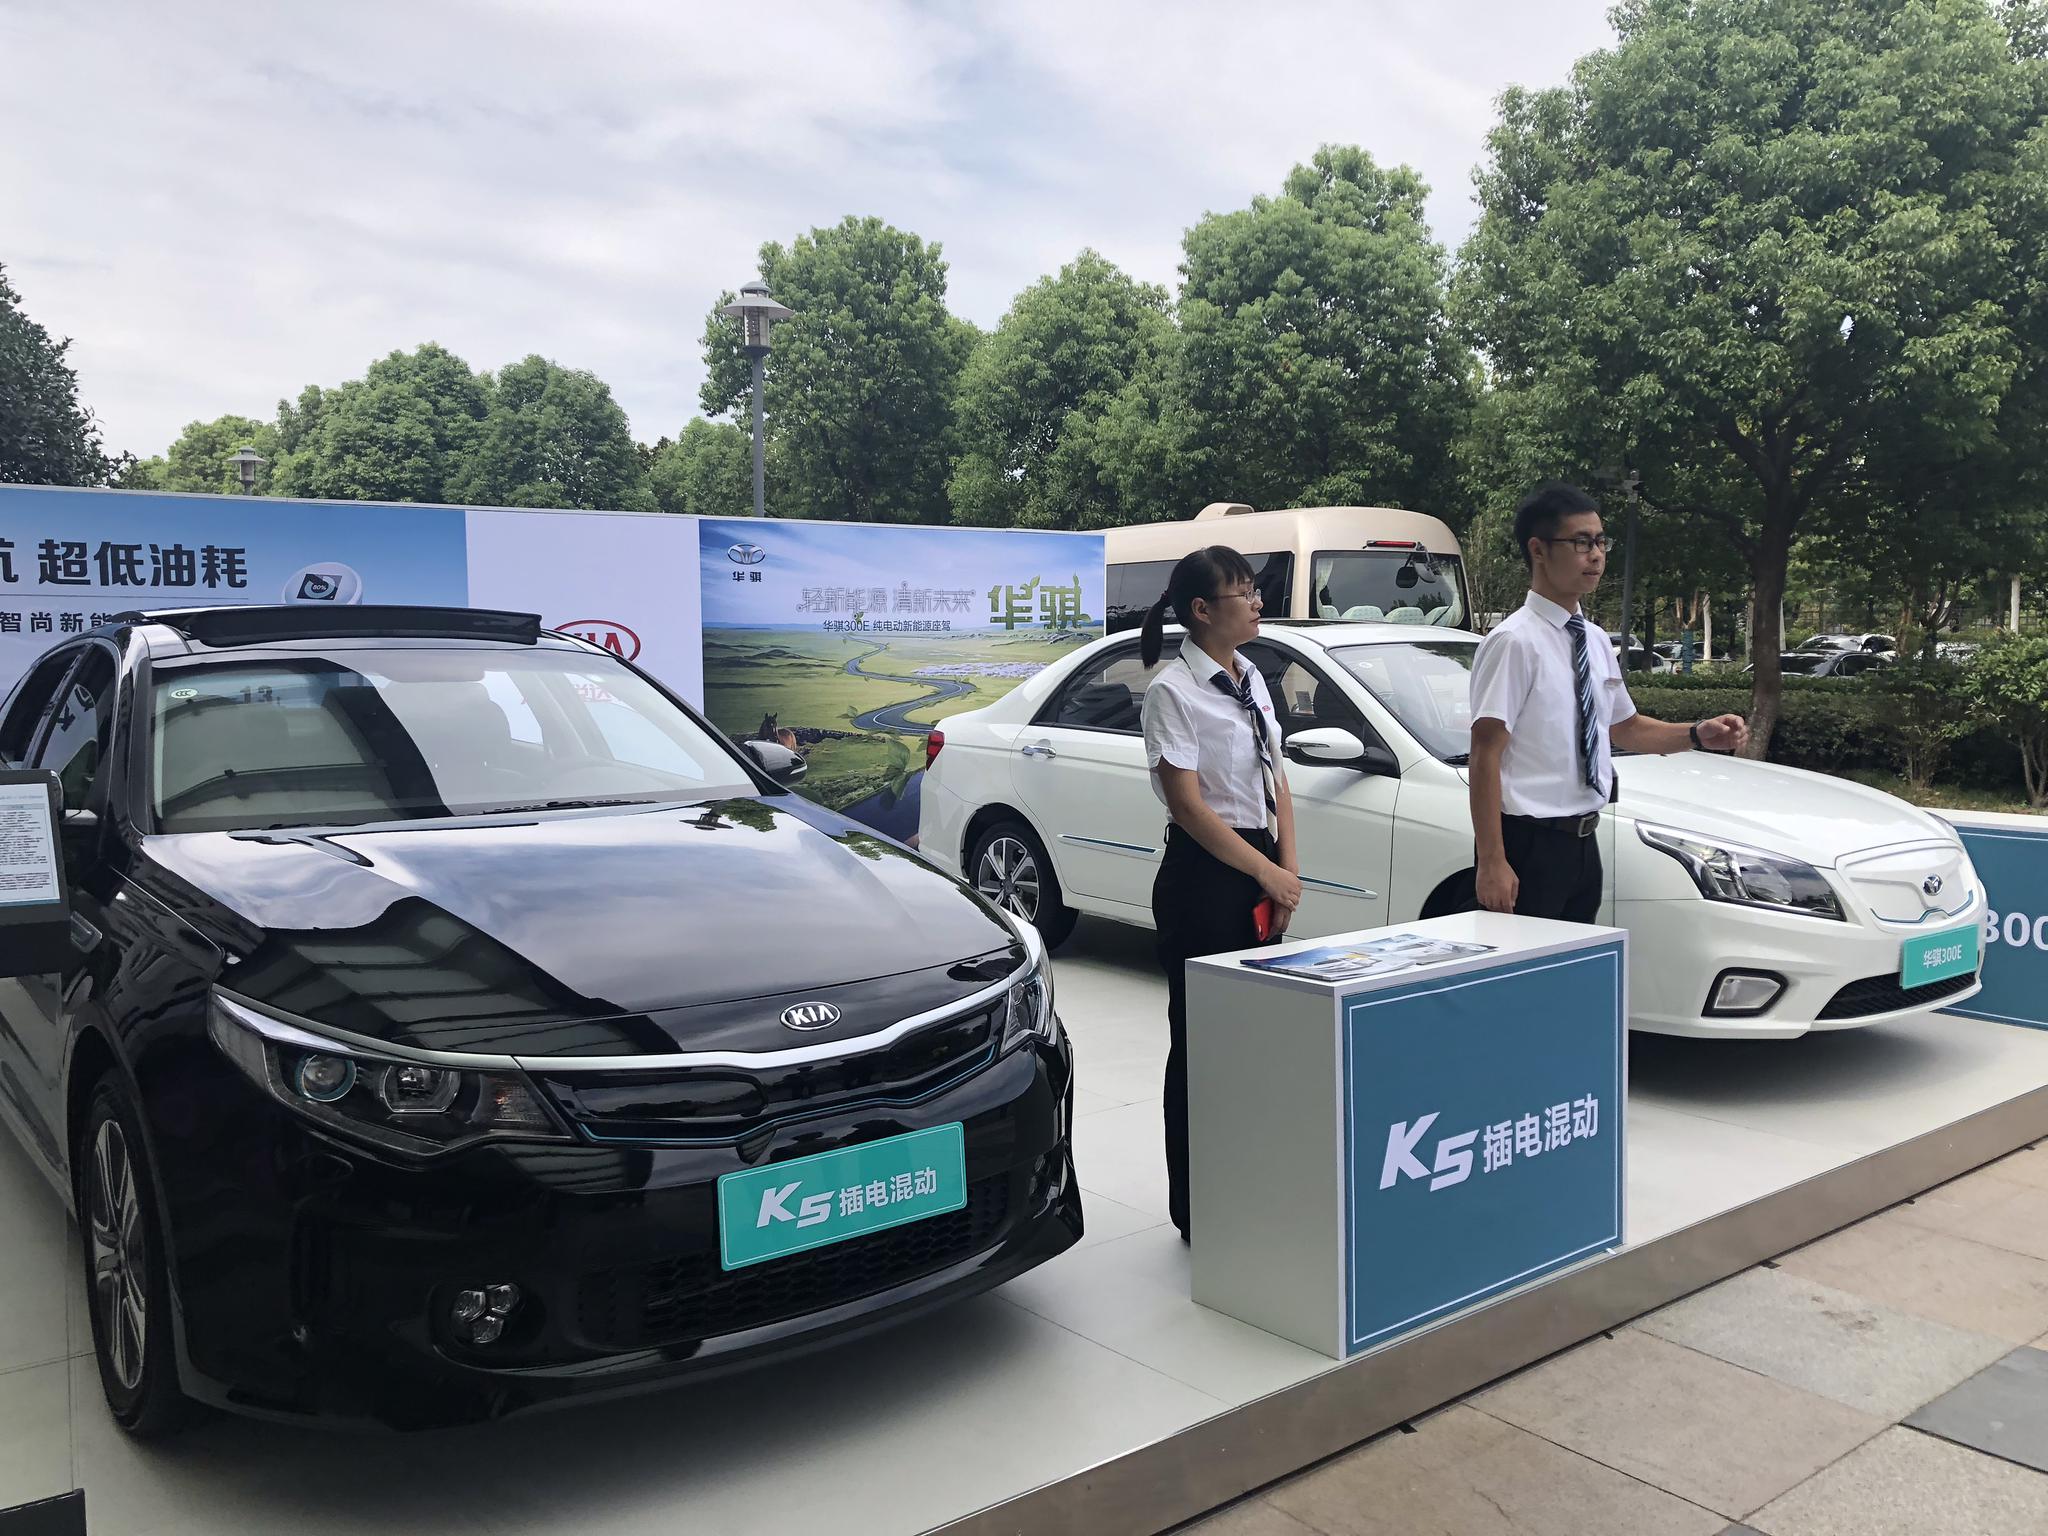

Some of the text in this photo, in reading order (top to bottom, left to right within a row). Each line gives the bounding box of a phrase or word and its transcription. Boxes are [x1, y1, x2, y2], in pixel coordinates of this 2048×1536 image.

[38, 538, 248, 589] 超低油耗
[732, 571, 762, 582] 华骐
[797, 581, 976, 614] 轻新能源 清新未来
[988, 575, 1091, 631] 华骐
[823, 620, 951, 632] 华骐300E 纯电动新能源座驾
[1923, 944, 1962, 968] 华骐300E
[790, 1005, 836, 1025] KIA
[1379, 1093, 1599, 1192] K5 插电混动
[756, 1166, 937, 1229] K5 插电混动
